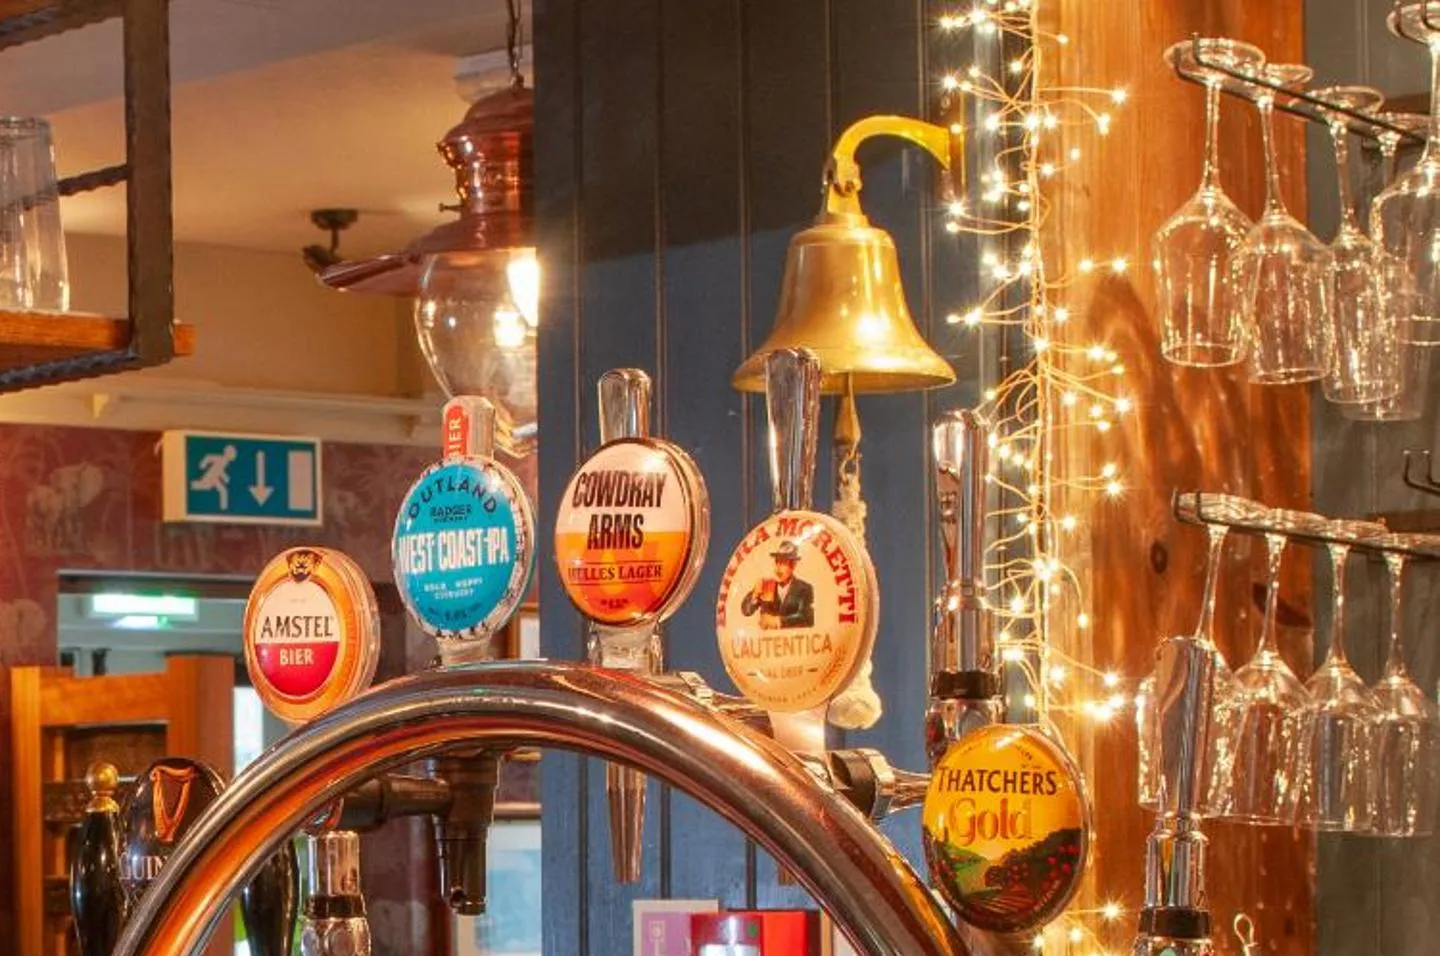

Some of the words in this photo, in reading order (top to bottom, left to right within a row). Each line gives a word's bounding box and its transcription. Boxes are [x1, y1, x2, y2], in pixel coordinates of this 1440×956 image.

[408, 475, 498, 520] OUTLAND
[572, 470, 668, 508] COWDRAY
[587, 513, 645, 550] ARMS
[398, 532, 435, 575] WEST
[438, 528, 483, 573] COAST
[618, 564, 664, 579] LAGER
[774, 517, 858, 625] MORETTI
[261, 615, 334, 639] AMSTEL
[279, 648, 315, 666] BIER
[937, 766, 1058, 796] THATCHERS
[949, 797, 1034, 847] Gold
